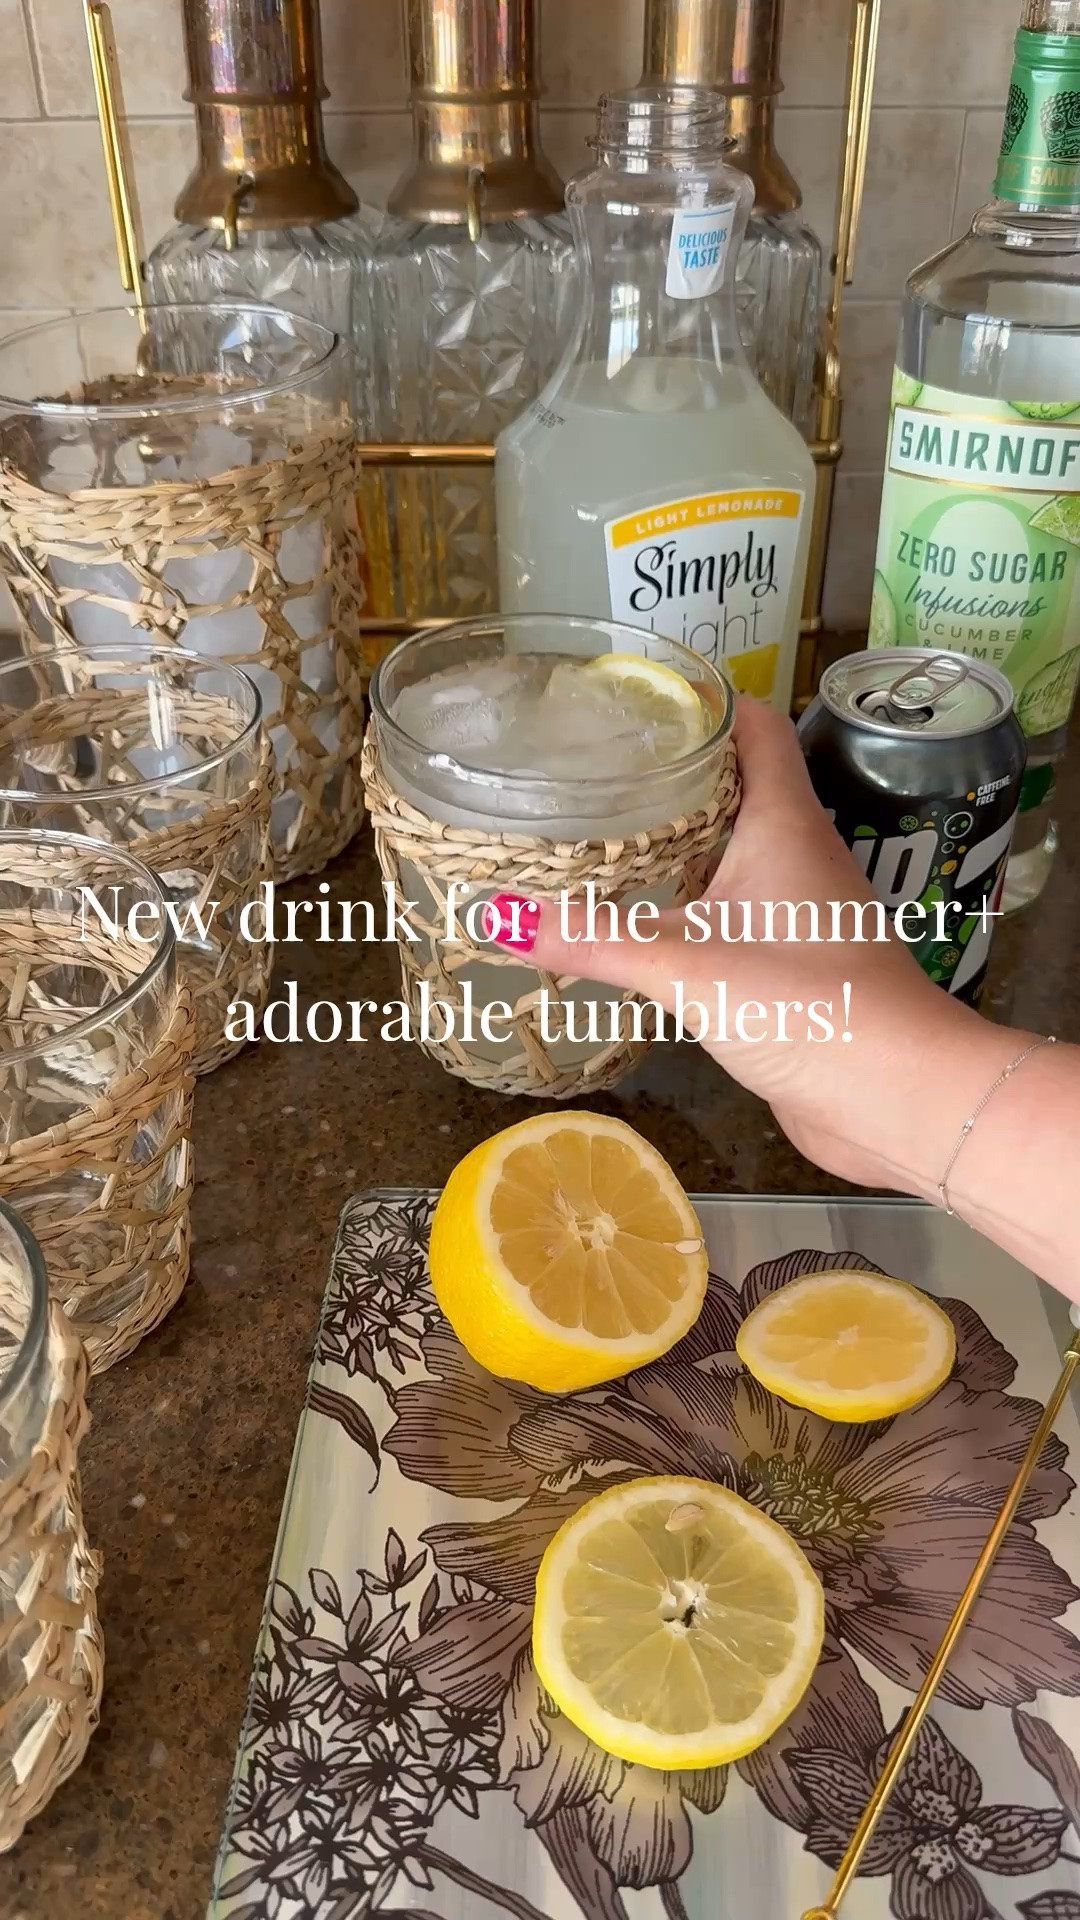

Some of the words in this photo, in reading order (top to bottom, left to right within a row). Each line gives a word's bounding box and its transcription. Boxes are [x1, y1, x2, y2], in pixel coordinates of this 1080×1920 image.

[678, 227, 728, 249] DELICIOUS
[683, 246, 720, 269] TASTE
[635, 509, 689, 535] LIGHT
[696, 498, 784, 518] LEMONADE
[896, 530, 957, 578] ZERO
[967, 549, 1068, 585] SUGAR
[628, 530, 779, 612] Simply
[903, 575, 1048, 620] Infusions
[904, 614, 1033, 642] CUCUMBER
[922, 638, 933, 649] &
[977, 774, 1011, 797] CAFFEINE
[975, 791, 997, 807] FREE
